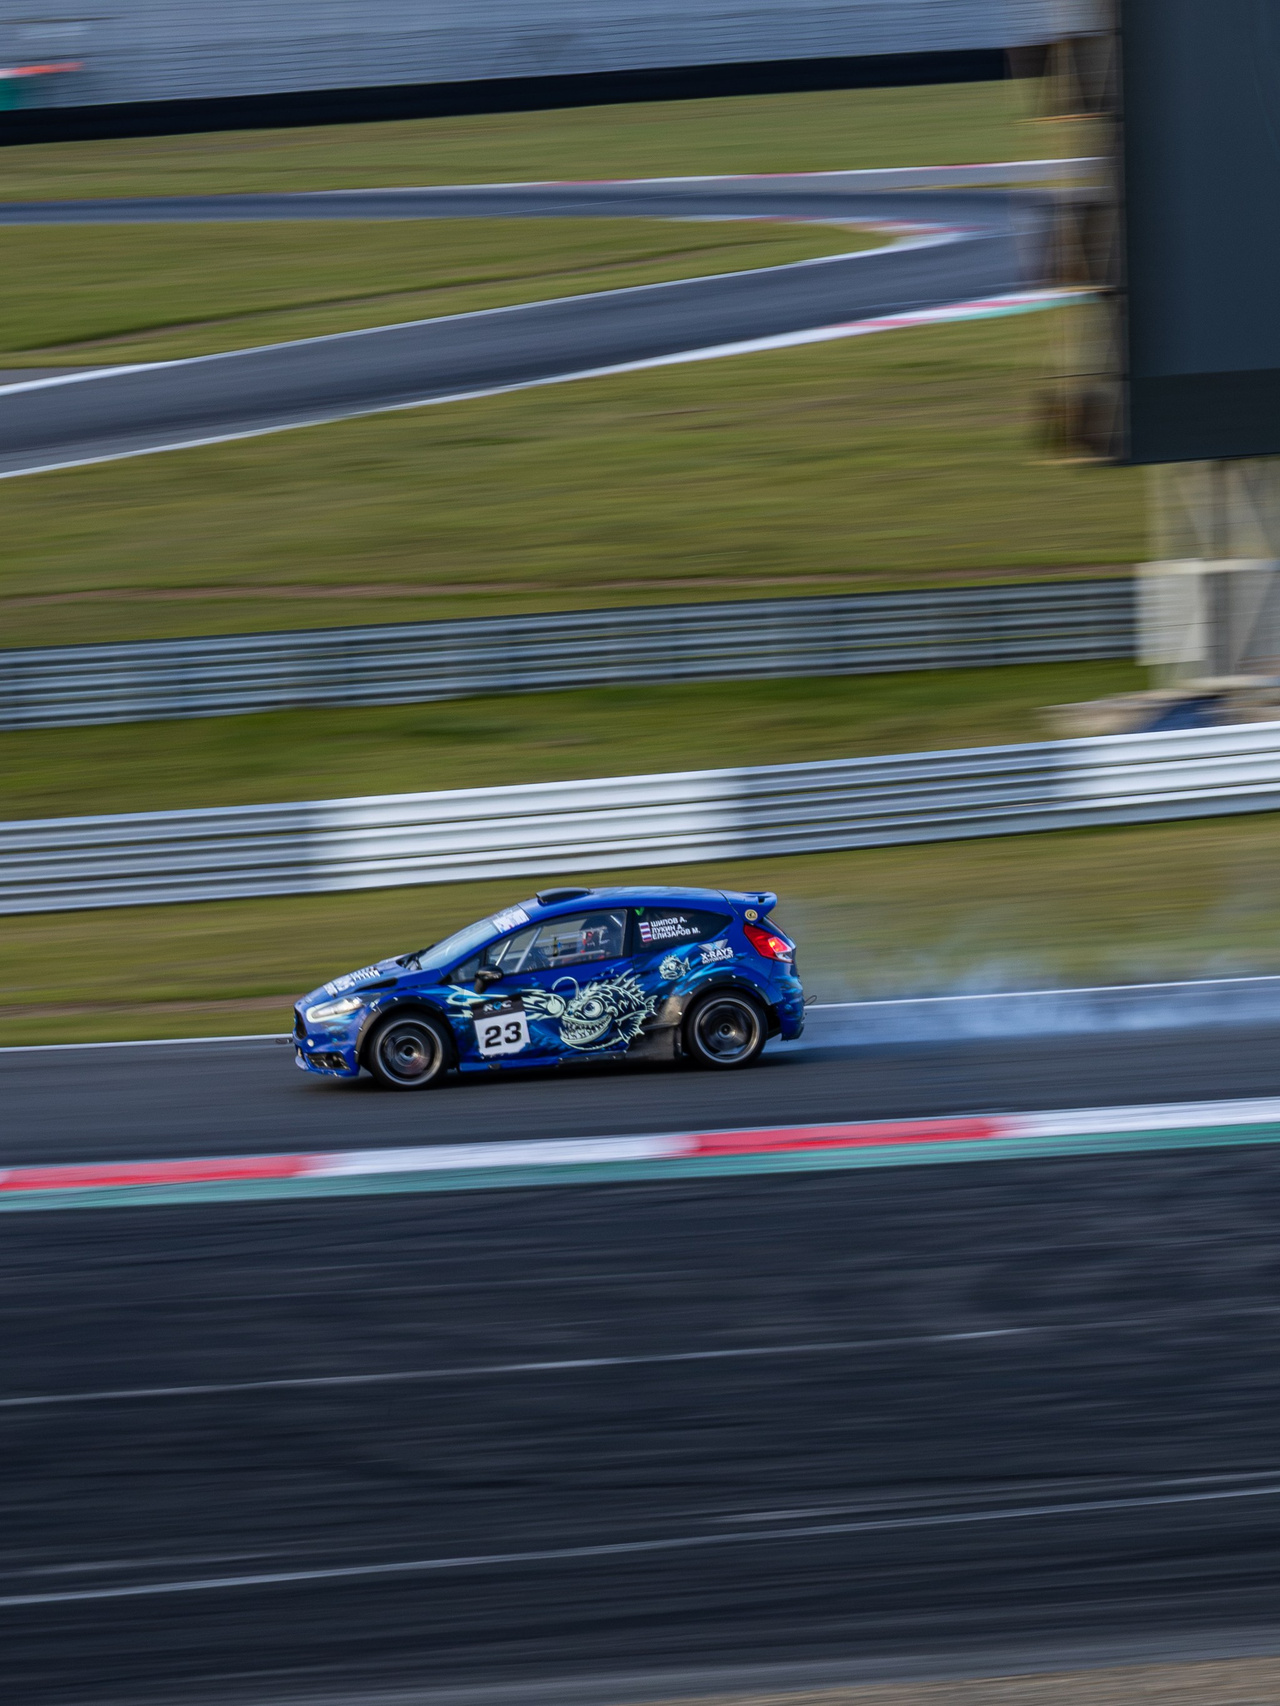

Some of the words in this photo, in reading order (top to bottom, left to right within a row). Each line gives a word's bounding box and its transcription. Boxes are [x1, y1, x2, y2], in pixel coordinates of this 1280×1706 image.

[650, 917, 679, 928] ШИПОВ
[679, 916, 687, 924] А.
[651, 924, 676, 934] ЛУКИН
[652, 928, 691, 940] ЕЛИЗАРОВ
[691, 926, 701, 935] М.
[700, 946, 733, 960] X-RAYS
[485, 1021, 522, 1048] 23
